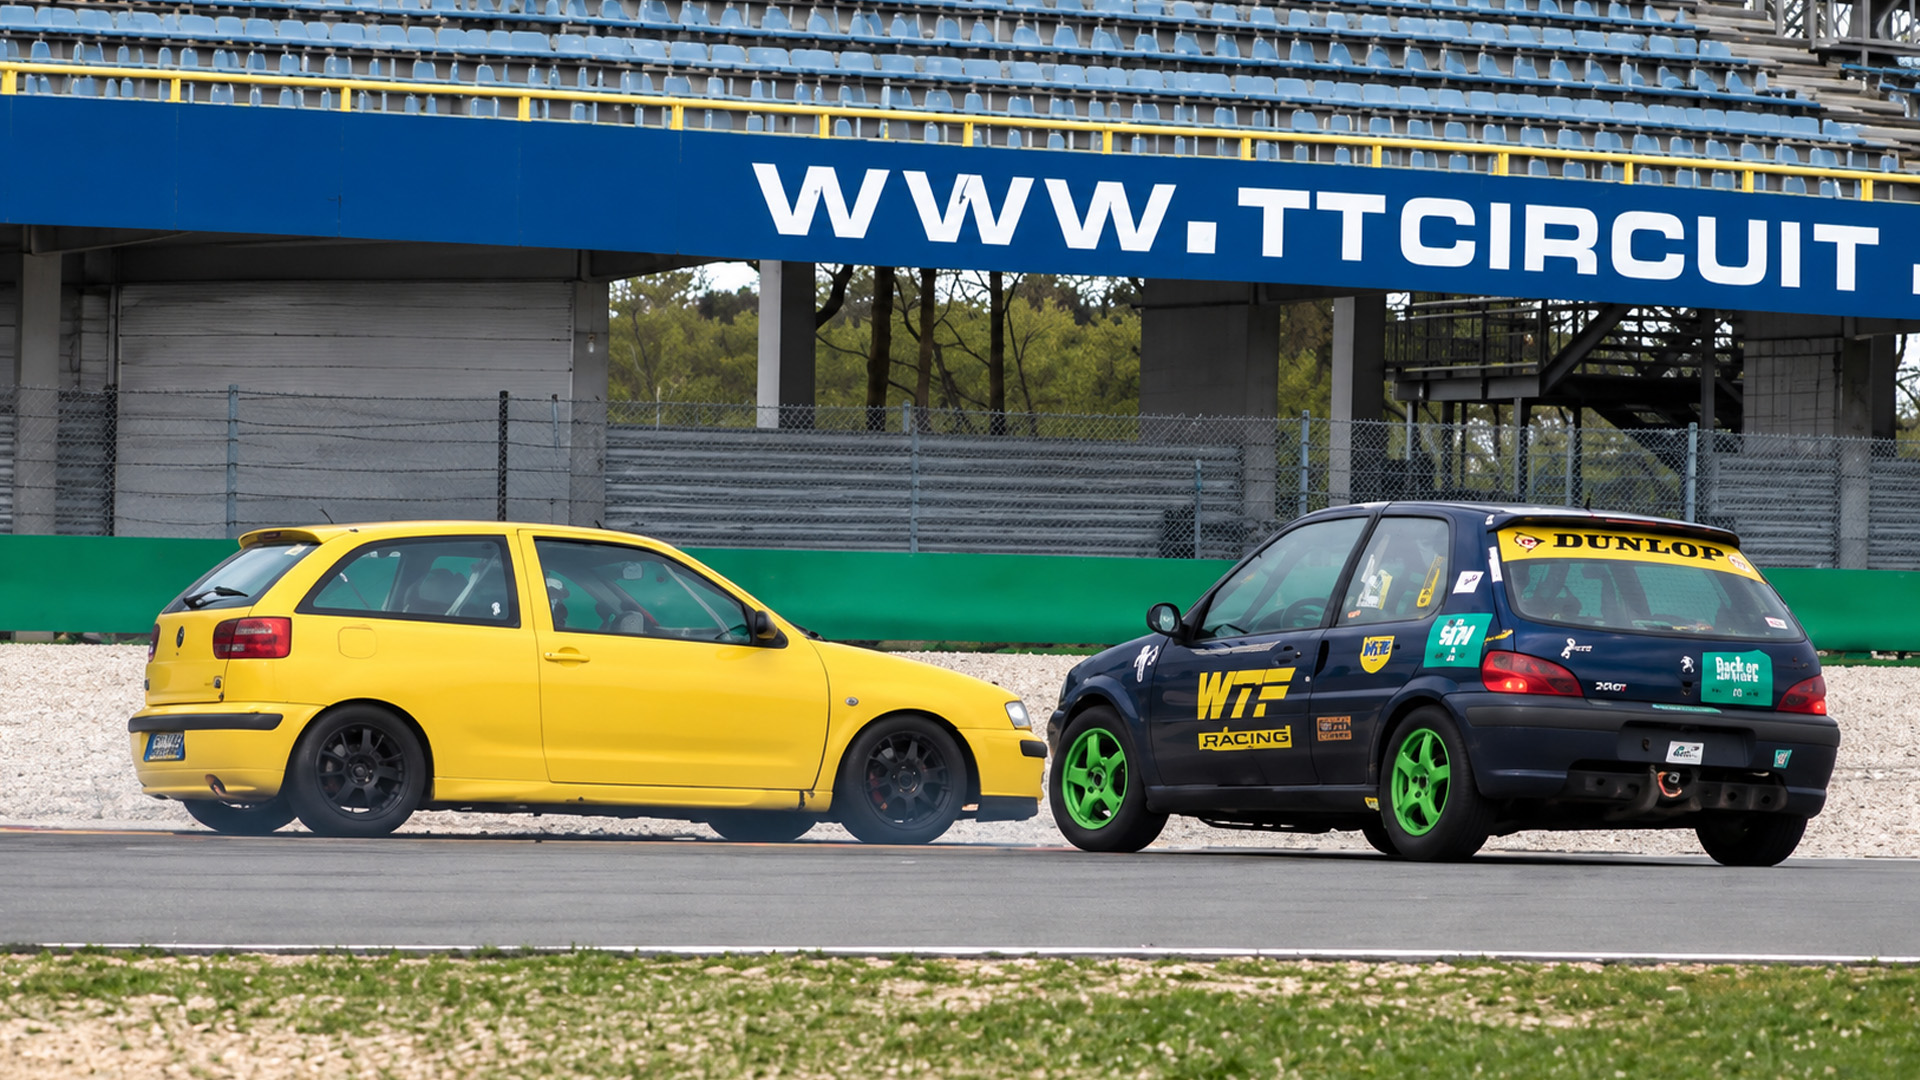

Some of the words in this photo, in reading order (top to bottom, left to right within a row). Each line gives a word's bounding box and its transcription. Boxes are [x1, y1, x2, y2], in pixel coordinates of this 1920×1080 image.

[752, 163, 1920, 295] WWW.TTCIRCUIT
[1552, 532, 1725, 562] DUNLOP
[1197, 667, 1296, 720] WTF
[1203, 727, 1290, 749] RACING
